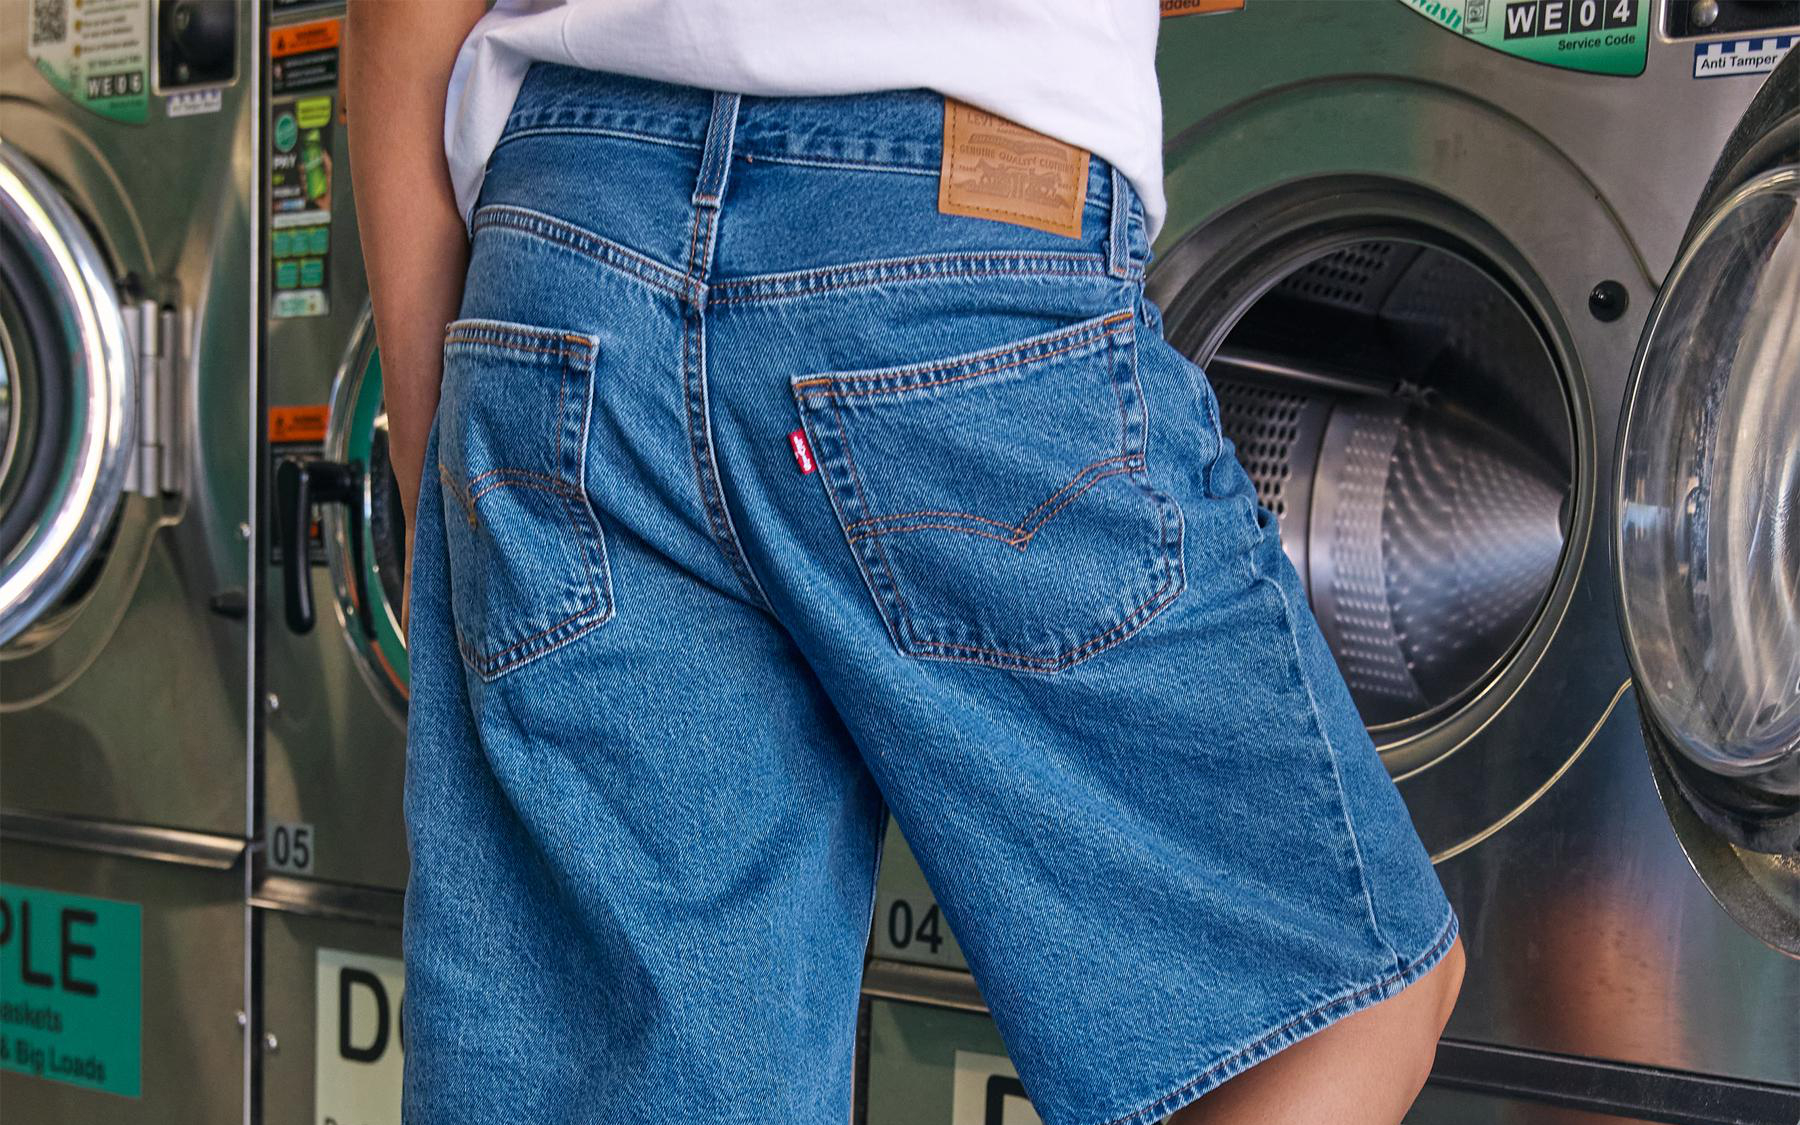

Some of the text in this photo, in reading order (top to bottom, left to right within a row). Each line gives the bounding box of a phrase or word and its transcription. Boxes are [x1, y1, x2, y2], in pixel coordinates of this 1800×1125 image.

[1558, 33, 1635, 51] Service Code
[1701, 55, 1777, 70] Anti Tamper
[999, 151, 1037, 167] QUALITY
[273, 826, 309, 869] 05
[888, 900, 943, 954] 04
[16, 1039, 44, 1078] Big
[49, 1046, 105, 1085] Loads
